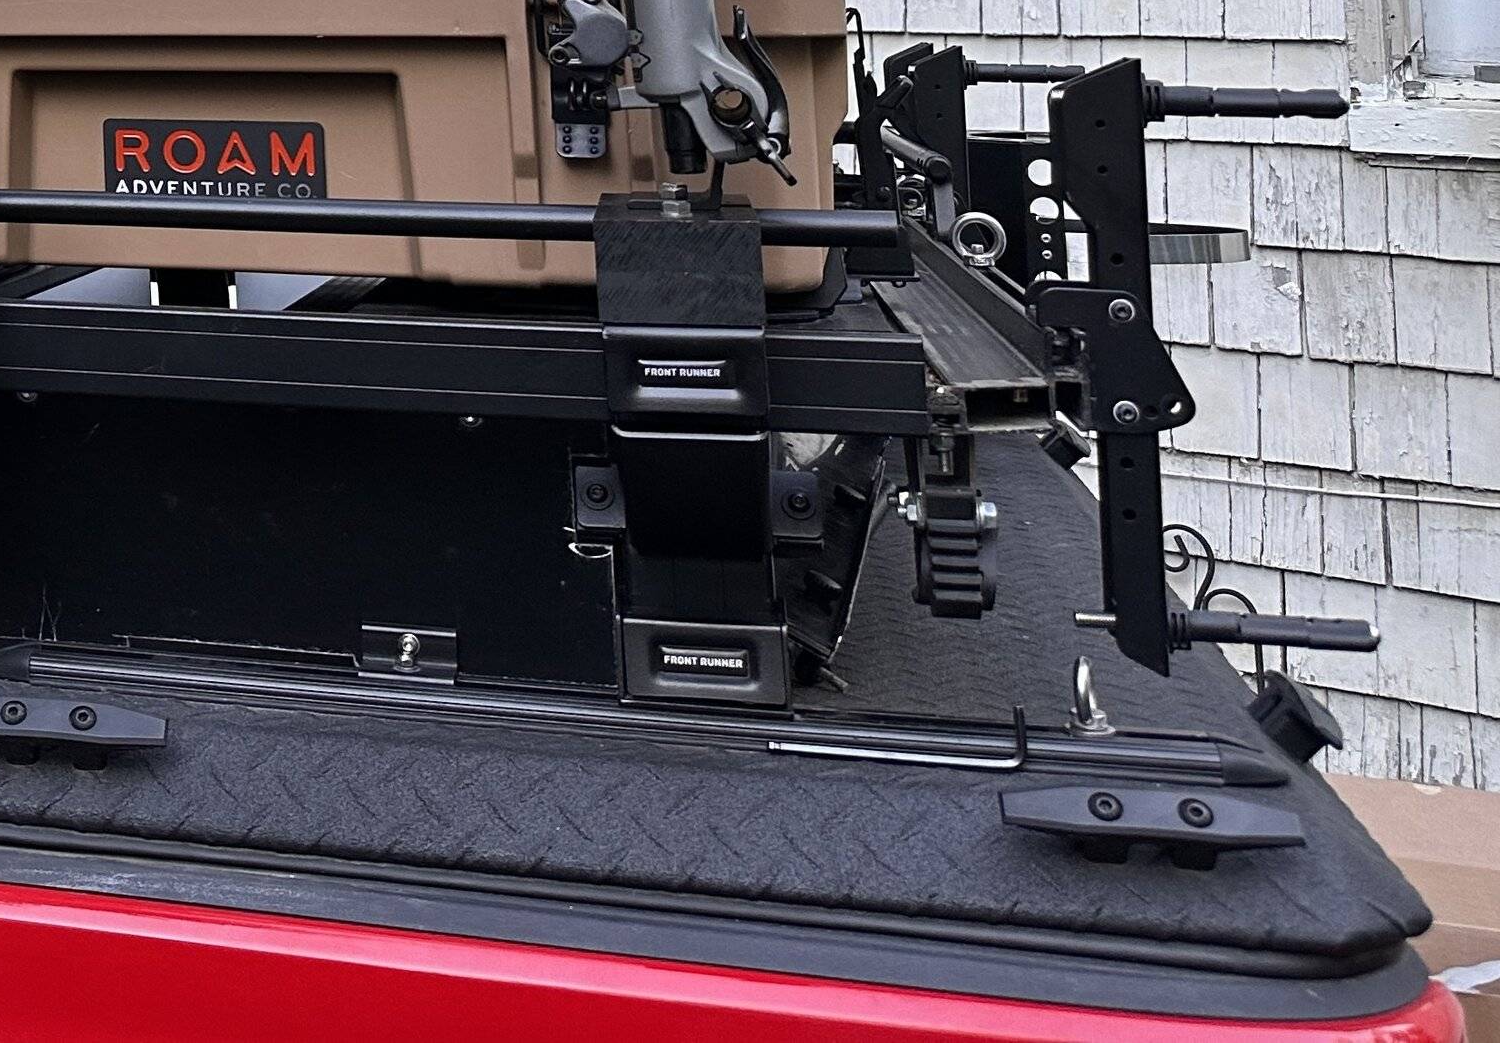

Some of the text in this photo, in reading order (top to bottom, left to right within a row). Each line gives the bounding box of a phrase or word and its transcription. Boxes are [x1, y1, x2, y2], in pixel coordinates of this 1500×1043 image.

[115, 128, 316, 176] ROAM
[115, 179, 267, 197] ADVENTURE
[644, 367, 721, 377] FRONT RUNNER
[663, 654, 744, 669] FRONT RUNNER
